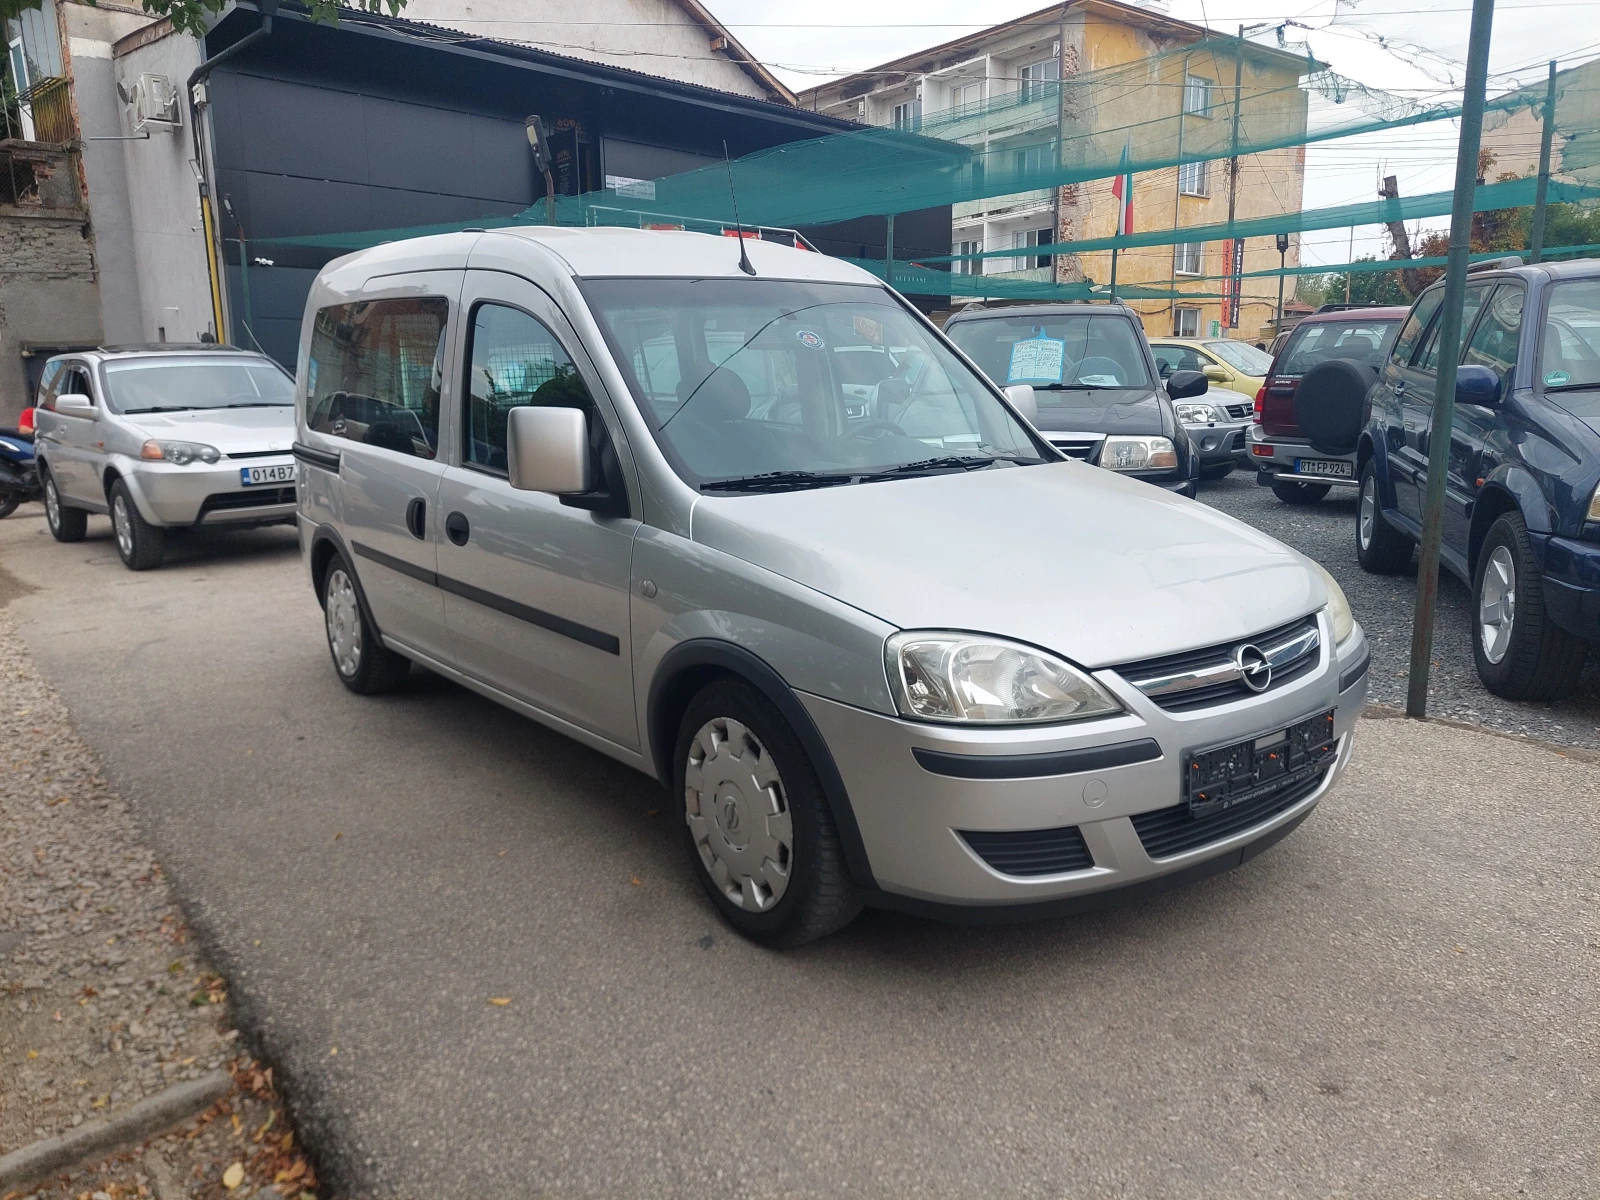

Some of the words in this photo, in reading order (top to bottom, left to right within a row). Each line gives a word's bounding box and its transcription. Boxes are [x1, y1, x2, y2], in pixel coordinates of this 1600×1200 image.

[1301, 461, 1312, 472] RT
[1317, 462, 1328, 472] FP
[1330, 463, 1345, 474] 924
